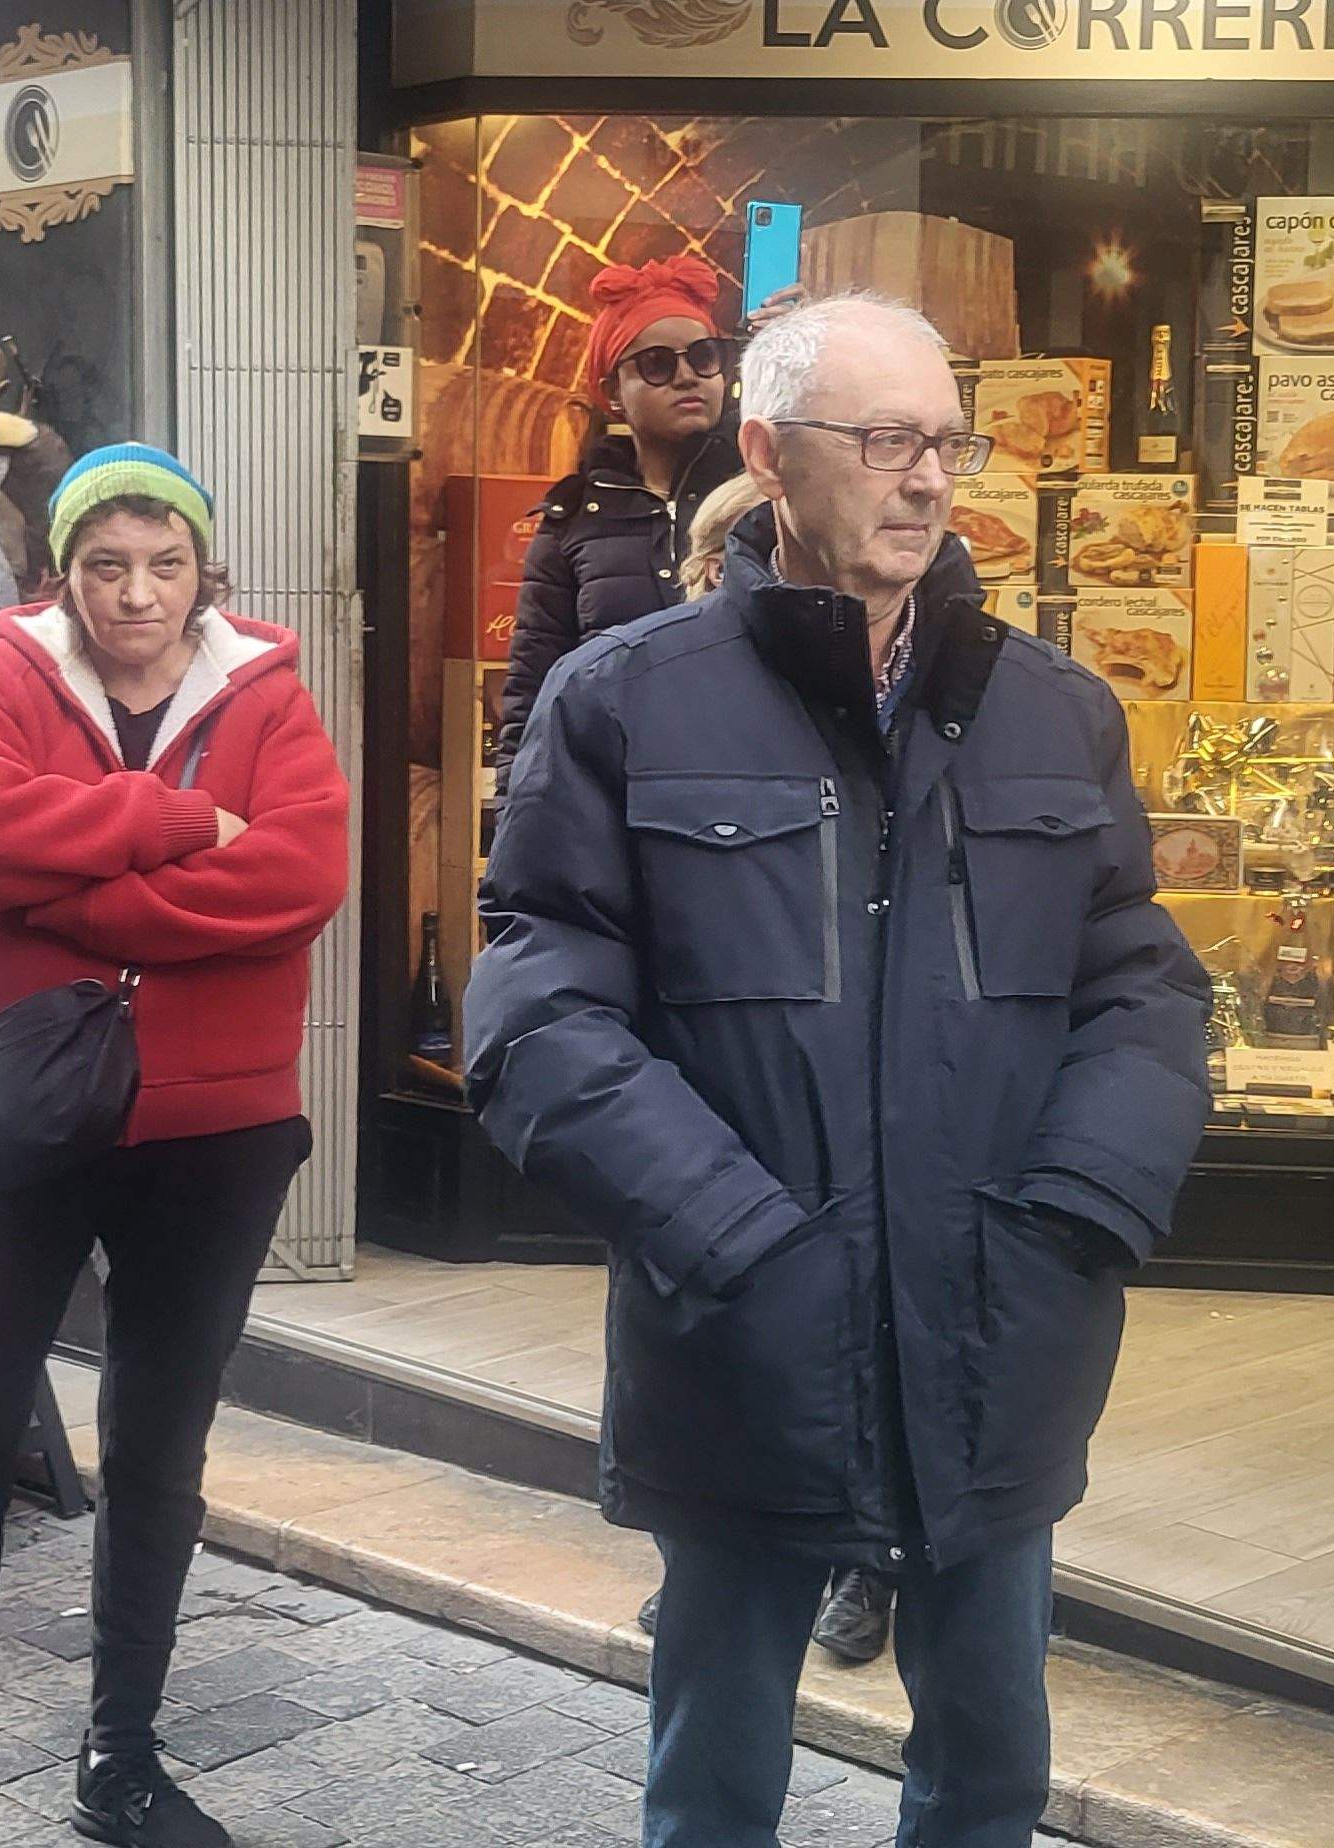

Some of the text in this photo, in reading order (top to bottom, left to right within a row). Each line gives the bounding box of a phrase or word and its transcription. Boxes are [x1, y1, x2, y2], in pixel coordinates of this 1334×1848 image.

[763, 0, 889, 48] LA
[1266, 212, 1324, 234] capón
[1229, 216, 1255, 315] cascajares
[1007, 366, 1064, 382] cascajares
[1268, 374, 1312, 392] pavo
[1122, 479, 1163, 492] trufada
[969, 489, 1029, 503] cascajares
[1112, 491, 1172, 503] cascajares
[1289, 505, 1326, 513] TABLAS
[1051, 496, 1070, 555] cascajare
[1078, 595, 1157, 607] cordero lechal
[1126, 607, 1186, 619] cascajares
